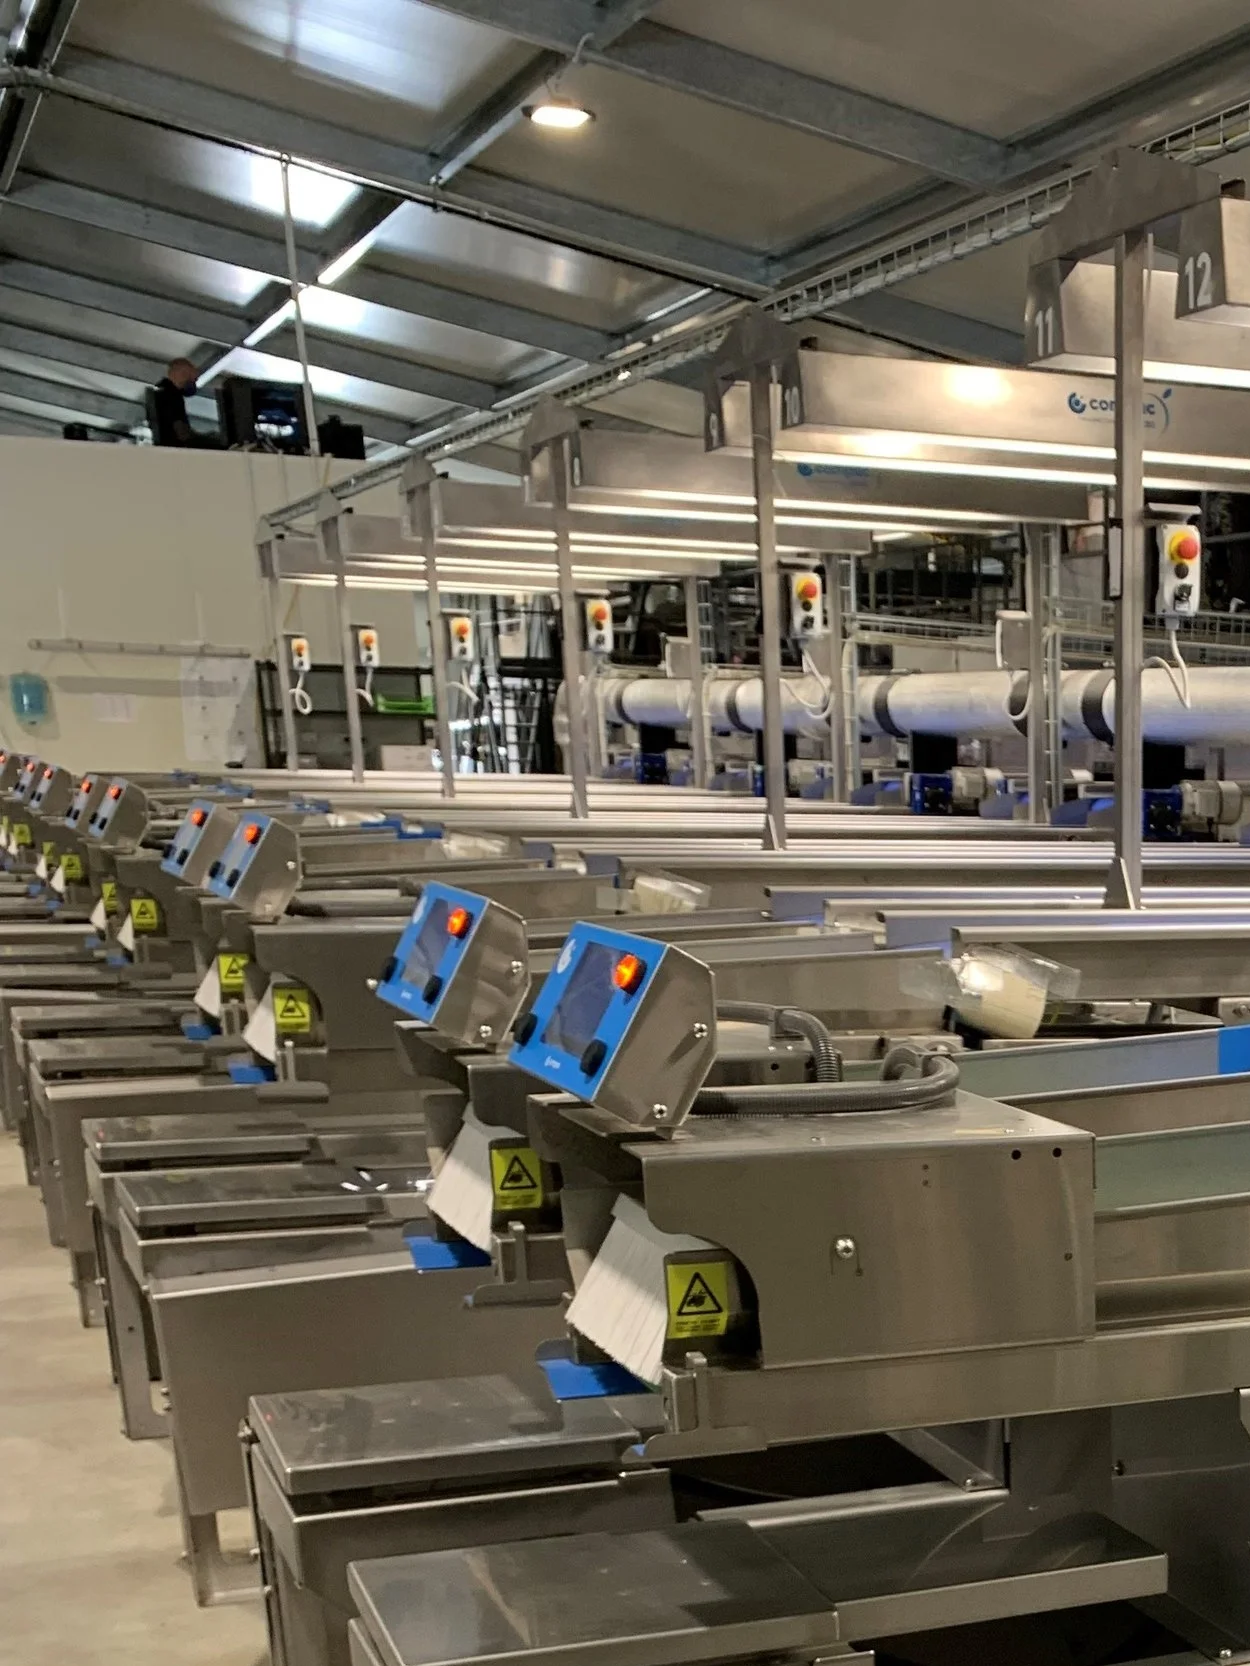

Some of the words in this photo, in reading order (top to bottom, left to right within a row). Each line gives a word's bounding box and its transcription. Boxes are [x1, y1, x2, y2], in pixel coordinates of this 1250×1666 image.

[1185, 251, 1213, 310] 12
[1035, 306, 1053, 358] 11
[784, 386, 800, 426] 10
